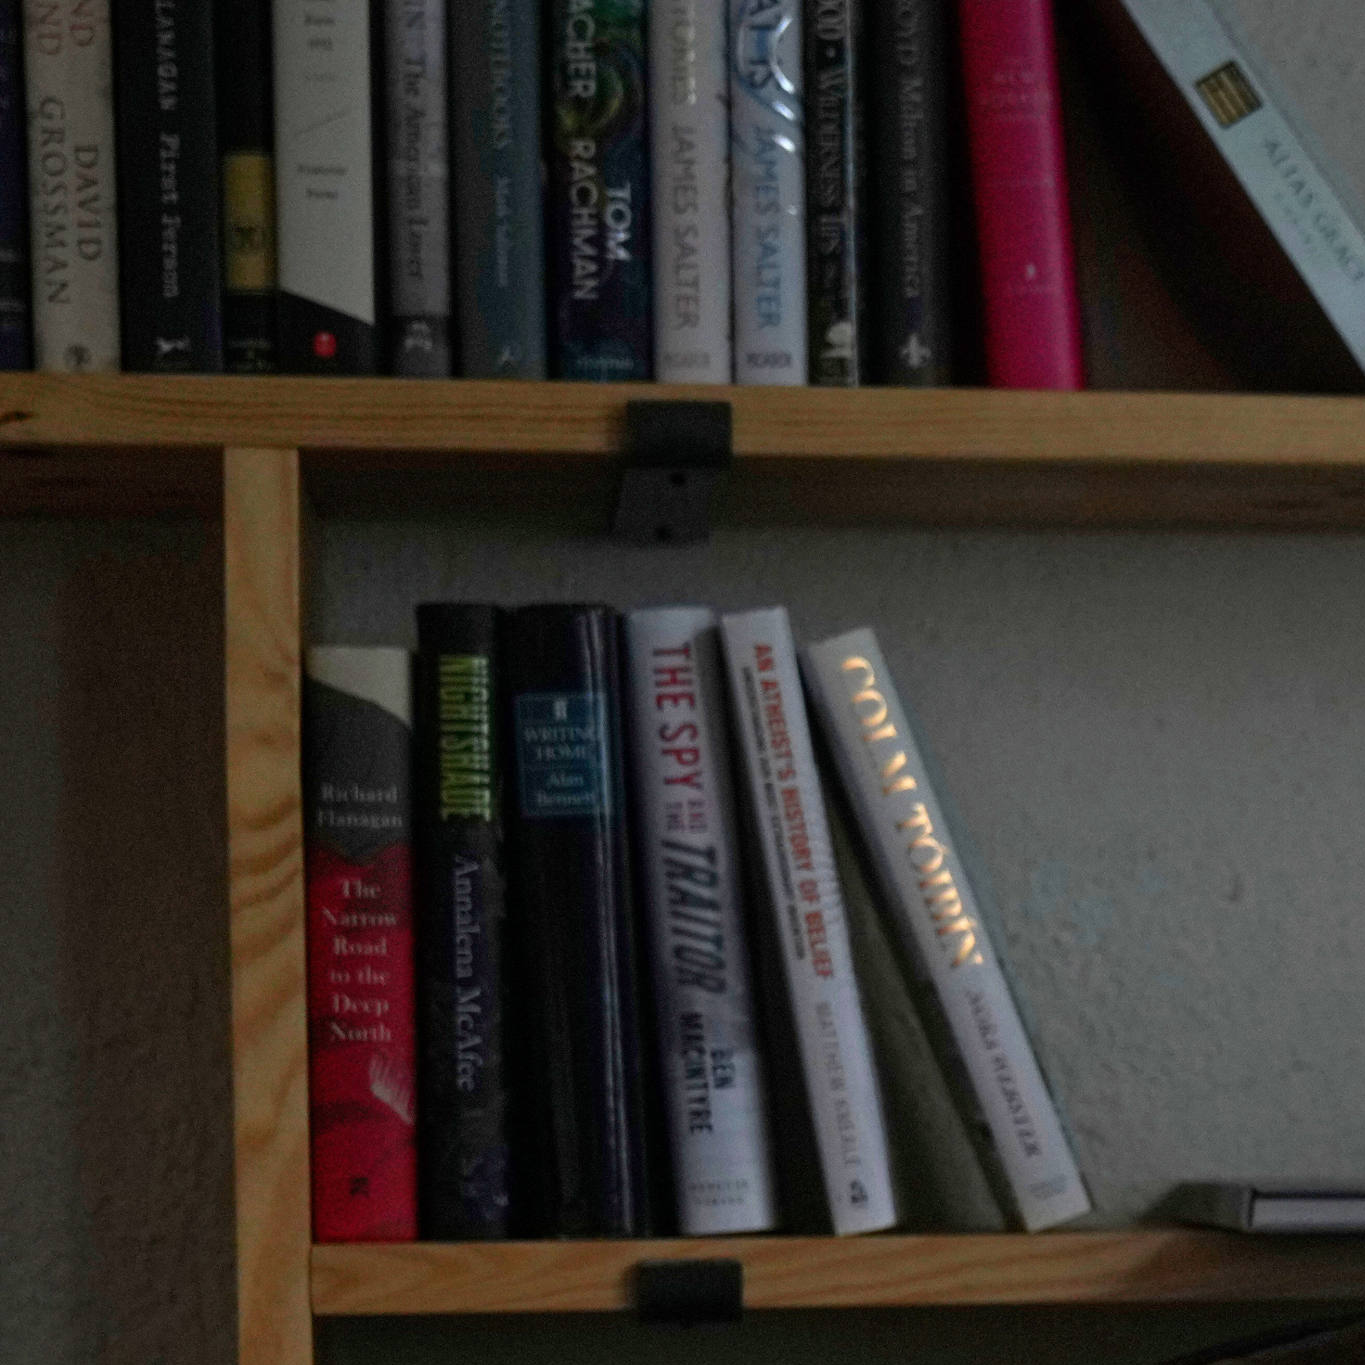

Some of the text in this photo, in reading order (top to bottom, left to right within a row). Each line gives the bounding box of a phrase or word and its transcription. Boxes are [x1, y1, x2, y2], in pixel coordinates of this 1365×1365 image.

[404, 57, 426, 96] The
[39, 96, 70, 305] GROSSMAN
[75, 143, 102, 262] DAVID
[160, 132, 181, 207] First
[672, 125, 697, 216] JAMES
[754, 125, 780, 216] JAMES
[160, 212, 181, 298] Person
[407, 216, 430, 280] Lover
[568, 137, 599, 301] RACHMAN
[603, 181, 633, 262] TOM
[902, 202, 923, 298] America
[672, 224, 700, 331] SALTER
[755, 224, 782, 331] SALTER
[653, 641, 702, 791] THE SPY
[840, 655, 918, 796] COLM
[316, 809, 404, 830] Flanagan
[320, 783, 398, 804] Richard
[755, 643, 833, 978] AN ATHEIST'S HISTORY OF BELIEF
[321, 906, 398, 928] Narrow
[340, 879, 381, 900] The
[438, 653, 492, 1093] NIGHTSHADE Annalena McAfee
[660, 838, 728, 996] TRAITOR
[330, 966, 391, 986] to the
[333, 937, 388, 958] Road
[330, 1022, 393, 1043] North
[331, 993, 391, 1018] Deep
[814, 1000, 846, 1092] MATTHEW
[677, 1011, 714, 1137] MACINTYRE
[710, 1047, 737, 1091] BEN
